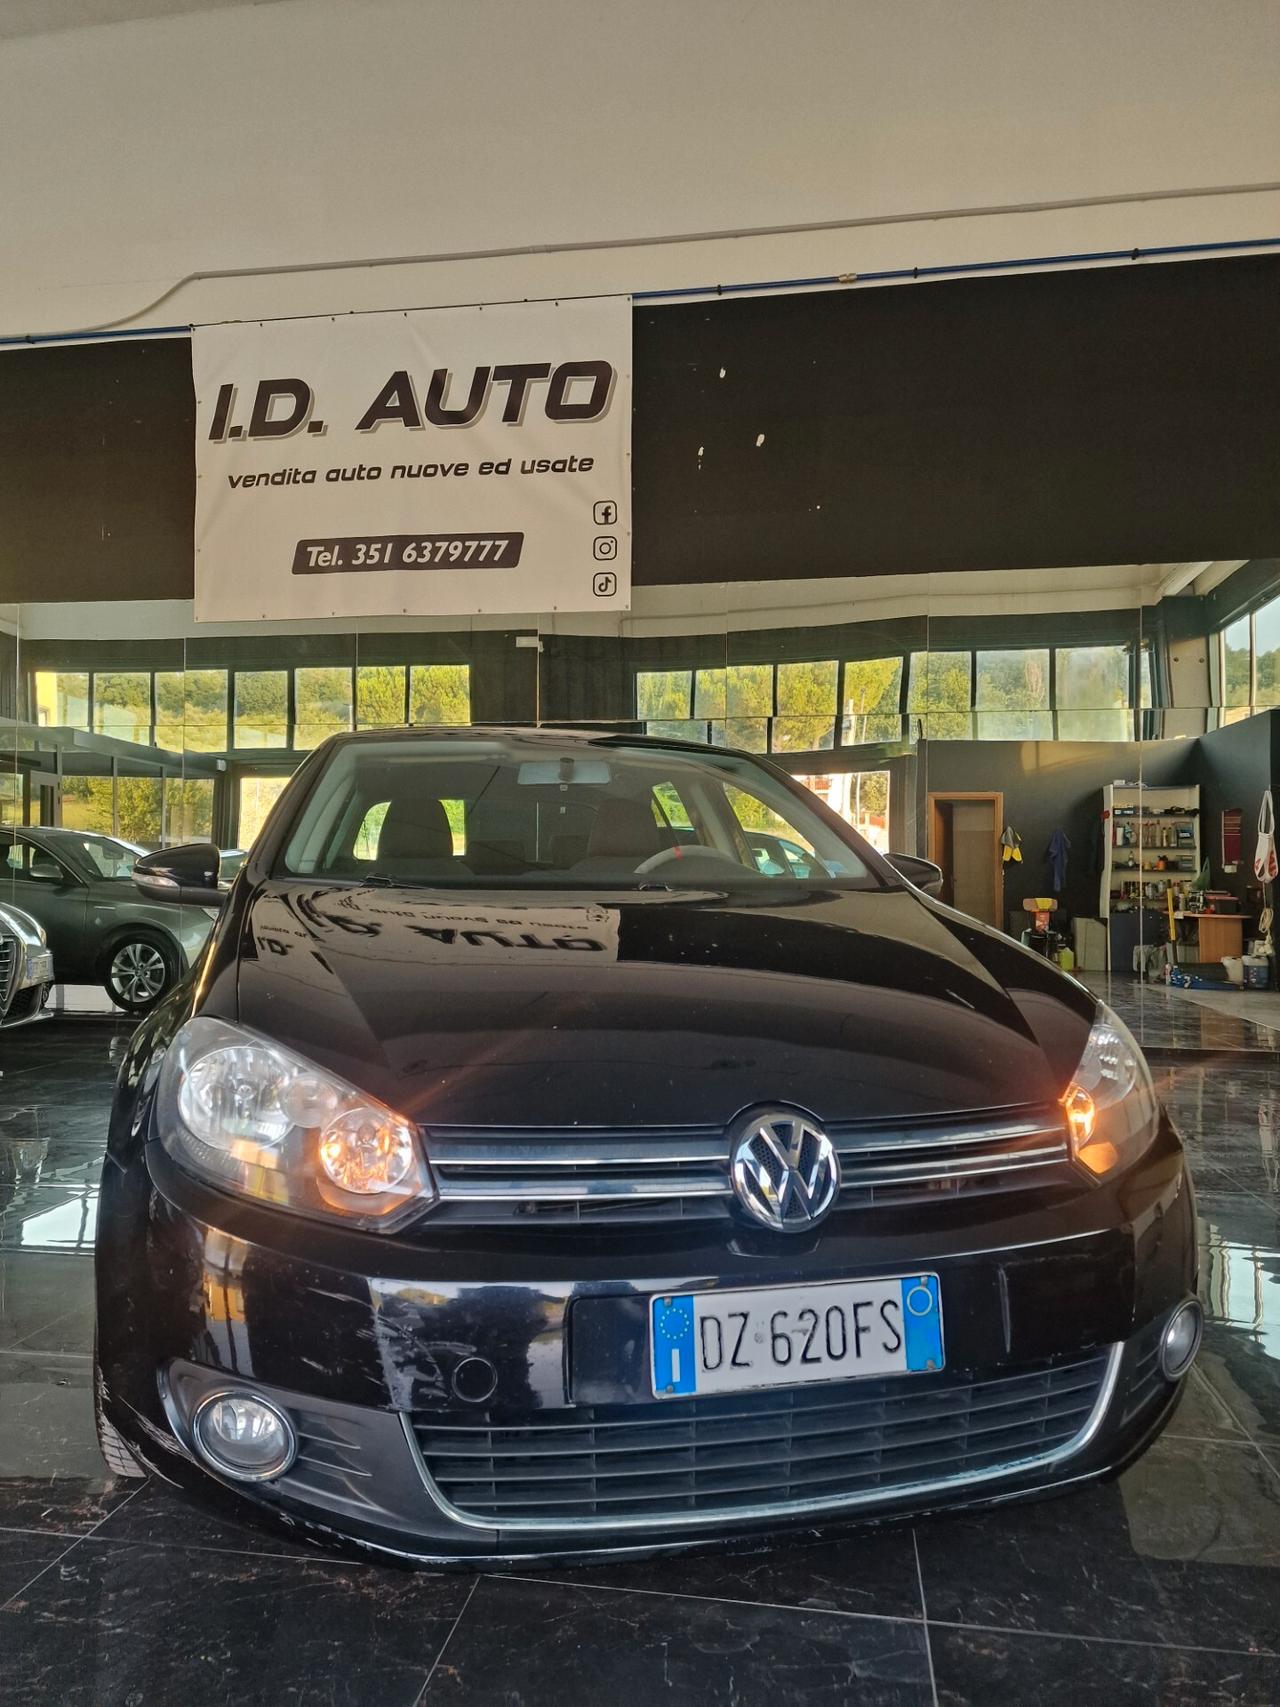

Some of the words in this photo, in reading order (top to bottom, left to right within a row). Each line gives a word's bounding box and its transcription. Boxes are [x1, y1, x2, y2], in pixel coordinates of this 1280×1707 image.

[208, 378, 327, 444] I.D.
[355, 360, 618, 432] AUTO
[228, 468, 317, 489] vendita
[325, 464, 382, 483] auto
[390, 462, 469, 479] nuove
[478, 458, 512, 475] ed
[520, 455, 594, 475] usate
[306, 544, 343, 567] Tel.
[352, 542, 393, 565] 351
[402, 540, 509, 564] 6379777
[700, 1312, 751, 1371] DZ
[769, 1300, 901, 1367] 620FS
